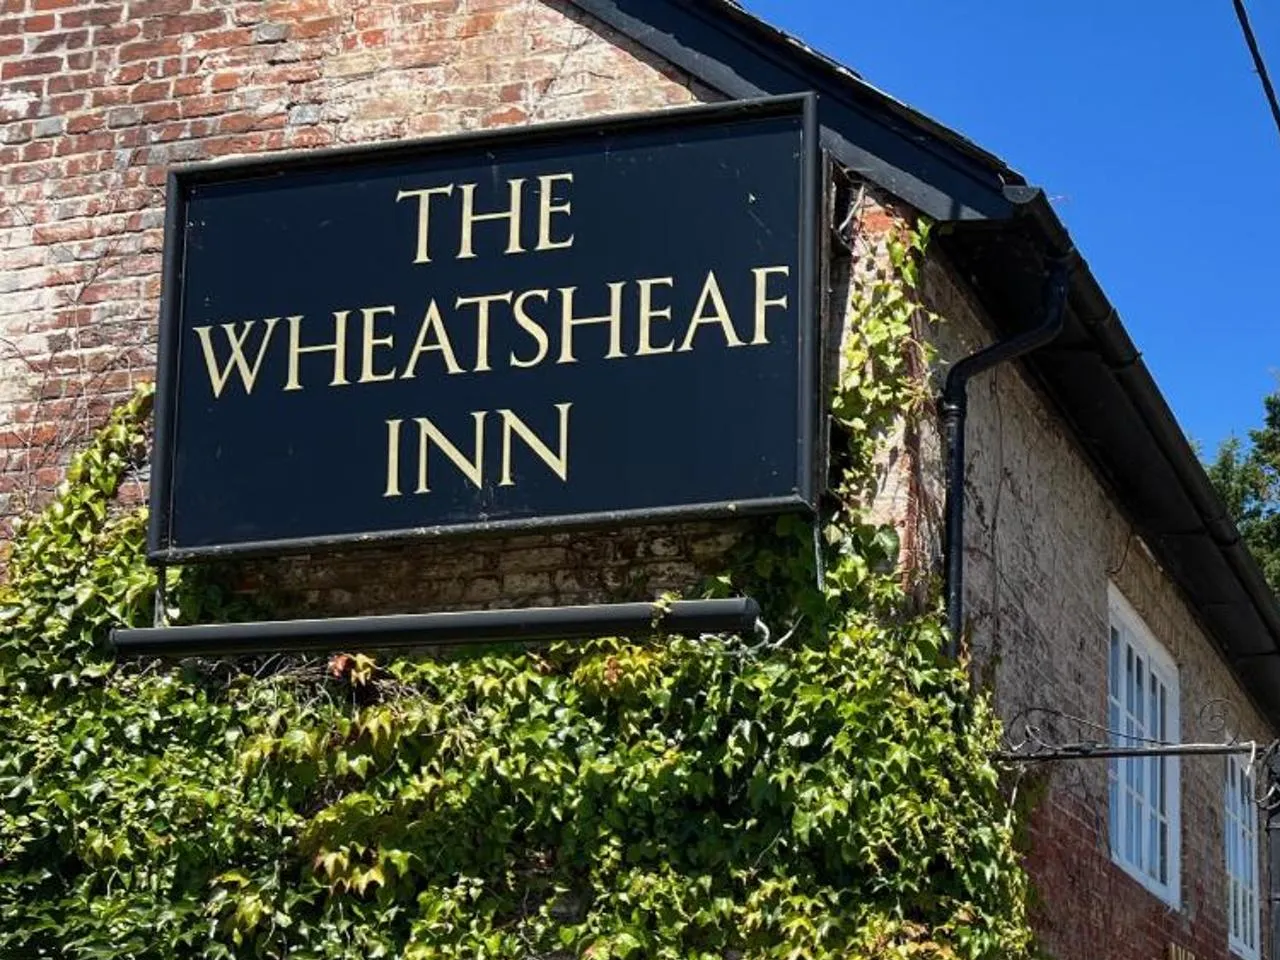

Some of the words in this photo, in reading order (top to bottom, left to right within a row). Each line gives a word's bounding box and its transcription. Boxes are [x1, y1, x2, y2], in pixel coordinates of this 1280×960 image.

[396, 173, 575, 264] THE
[192, 266, 790, 398] WHEATSHEAF
[382, 402, 573, 497] INN
